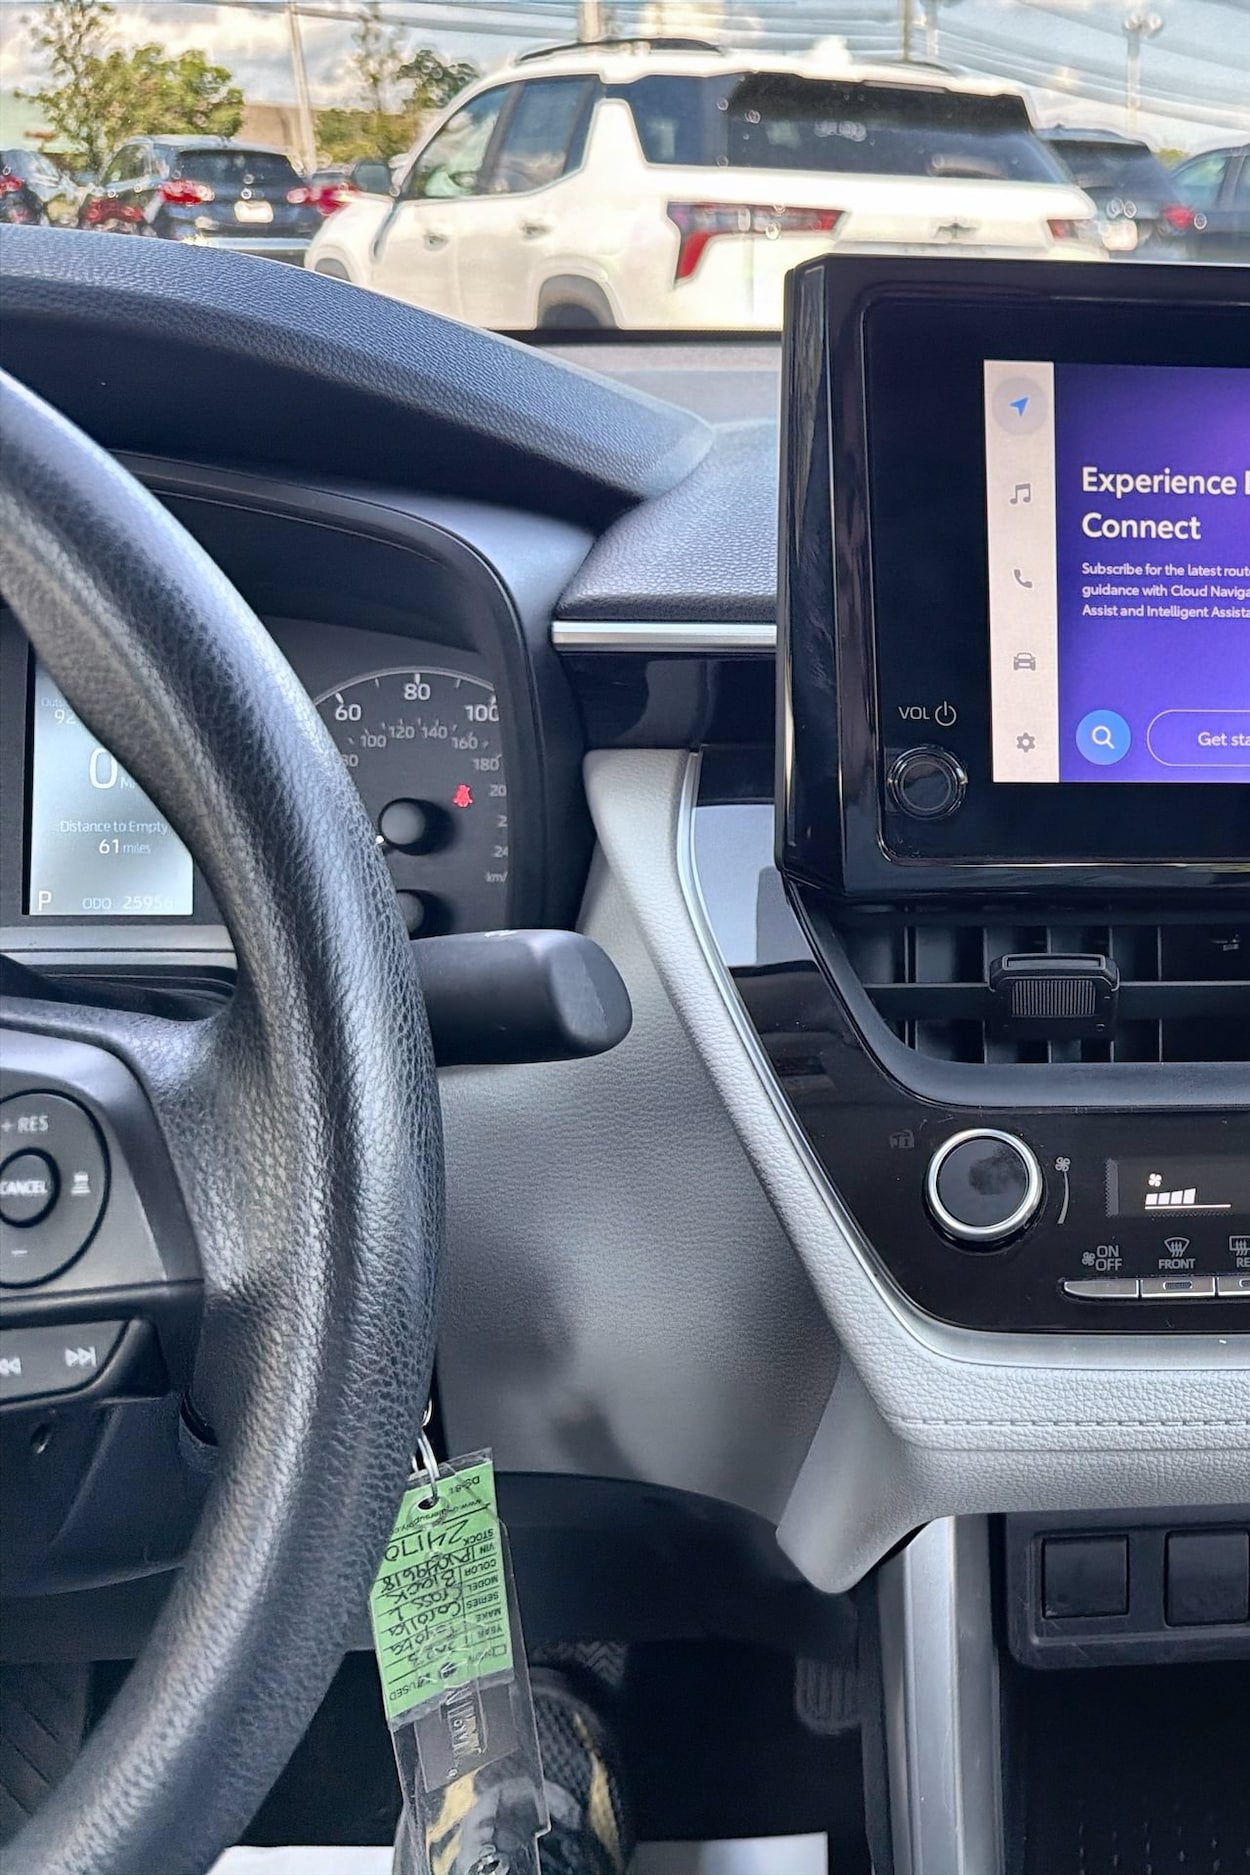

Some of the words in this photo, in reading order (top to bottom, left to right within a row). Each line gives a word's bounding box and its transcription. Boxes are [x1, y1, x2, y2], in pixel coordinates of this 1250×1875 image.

[1082, 466, 1237, 499] Experience
[1081, 512, 1202, 540] Connect
[1081, 562, 1143, 576] Subscribe
[1145, 563, 1162, 577] for
[1164, 563, 1185, 577] the
[1187, 564, 1222, 577] latest
[1082, 584, 1140, 600] guidance
[1142, 584, 1168, 597] with
[1170, 585, 1208, 598] Cloud
[1082, 604, 1118, 617] Assist
[1120, 604, 1144, 618] and
[1146, 605, 1209, 621] Intelligent
[404, 683, 431, 701] 80
[335, 704, 362, 721] 60
[464, 704, 500, 722] 100
[899, 706, 930, 721] VOL
[388, 725, 415, 739] 120
[421, 725, 448, 739] 140
[1198, 731, 1228, 748] Get
[360, 735, 387, 748] 100
[452, 737, 478, 750] 160
[90, 747, 118, 789] 0
[473, 757, 500, 771] 180
[60, 820, 111, 833] Distance
[113, 821, 127, 833] to
[129, 820, 168, 836] Empty
[99, 838, 120, 854] 61
[123, 843, 151, 854] miles
[38, 890, 52, 911] P
[82, 897, 112, 910] ODO
[0, 1180, 49, 1196] CANCEL
[1096, 1245, 1120, 1258] ON
[1095, 1258, 1123, 1272] OFF
[1158, 1258, 1195, 1270] FRONT
[384, 1519, 469, 1562] 24170
[463, 1528, 494, 1546] STOCK
[479, 1543, 495, 1554] VIN
[464, 1559, 497, 1577] COLOR
[467, 1575, 499, 1592] MODEL
[466, 1591, 499, 1609] SERIES
[476, 1607, 502, 1622] MAKE
